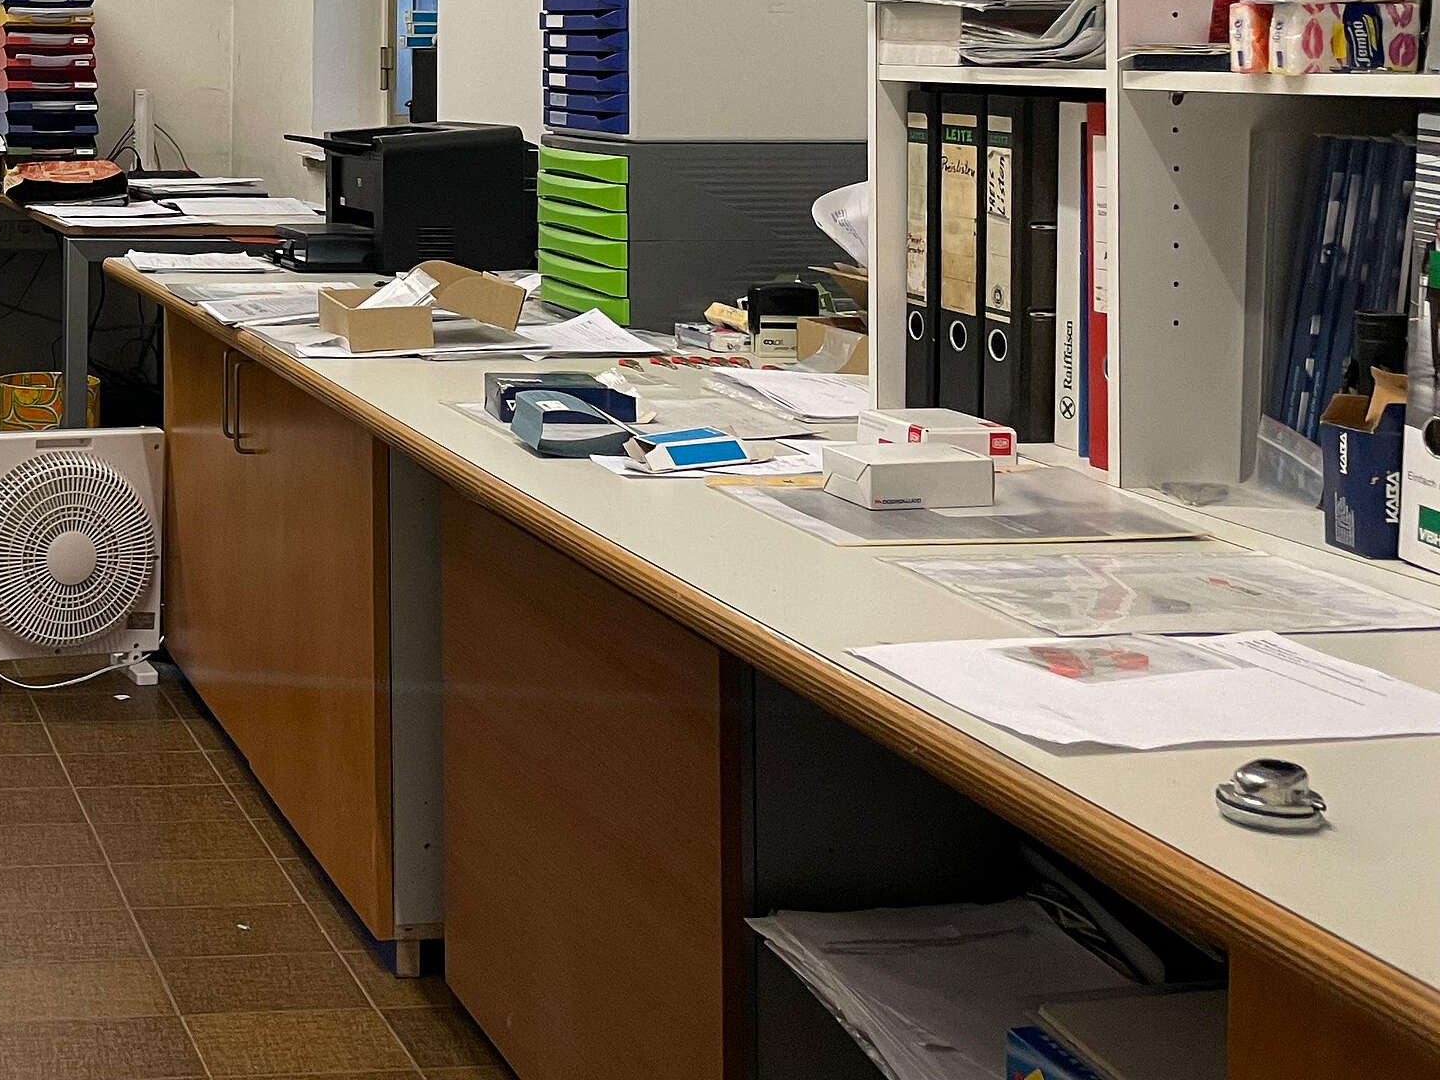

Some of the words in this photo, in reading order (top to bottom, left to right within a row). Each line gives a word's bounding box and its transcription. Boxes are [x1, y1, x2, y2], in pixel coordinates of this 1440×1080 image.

[1350, 20, 1371, 67] Tempo
[945, 127, 973, 142] LEITZ
[1063, 320, 1073, 391] Raiffeisen
[1339, 431, 1349, 475] KABA
[1385, 471, 1400, 524] KABA
